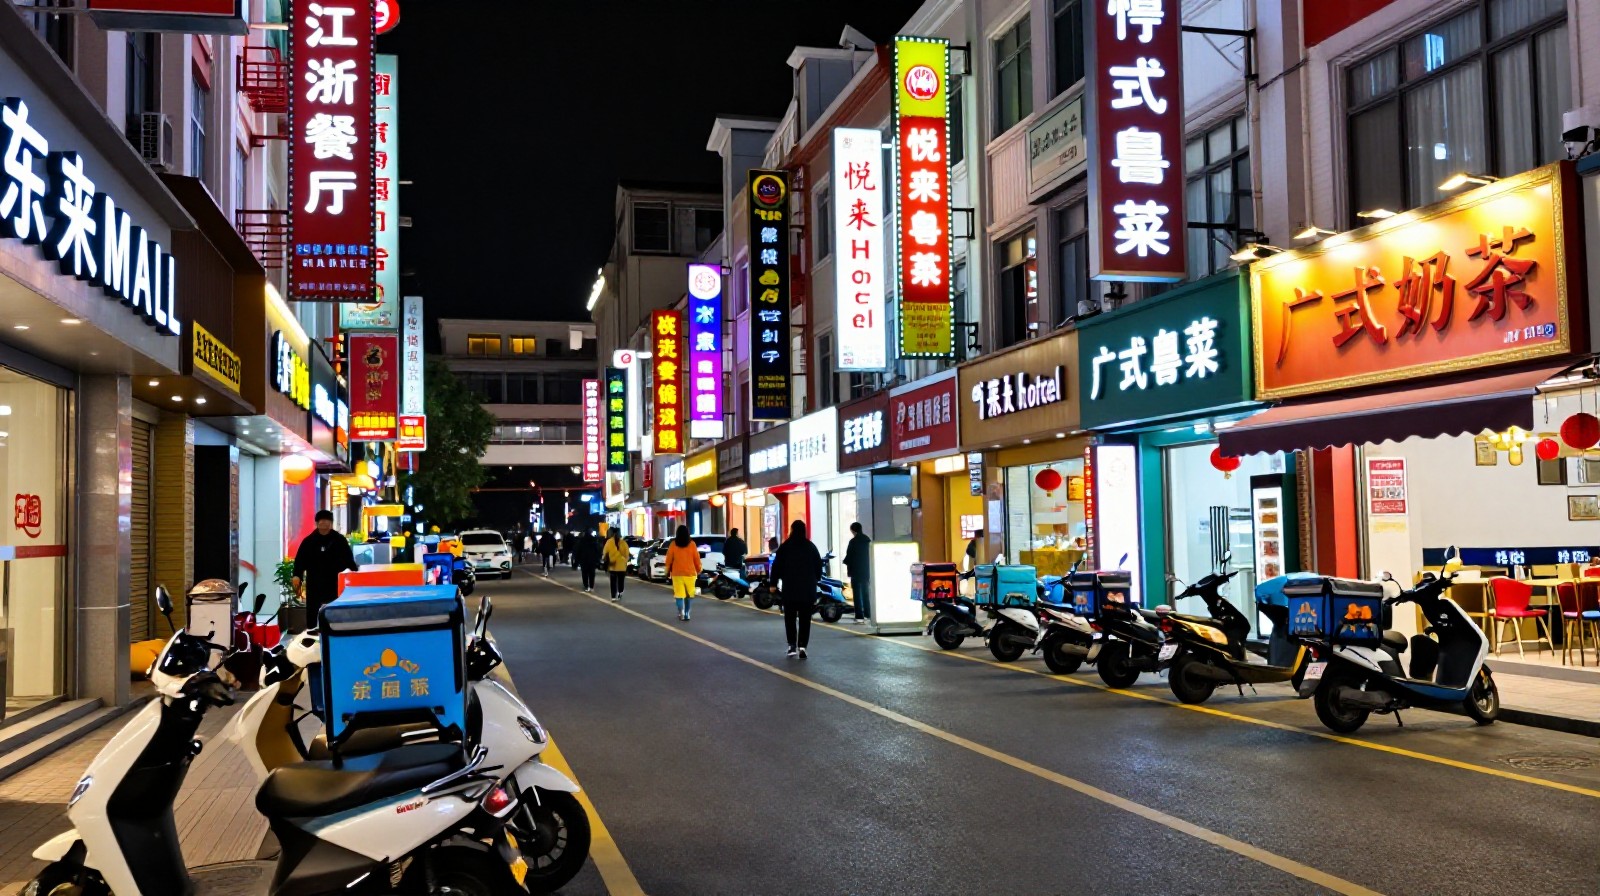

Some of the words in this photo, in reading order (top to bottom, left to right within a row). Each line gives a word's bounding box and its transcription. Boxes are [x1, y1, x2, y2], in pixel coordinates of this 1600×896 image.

[304, 2, 359, 216] 江浙餐厅
[1090, 316, 1219, 400] 广式粤菜
[1276, 226, 1537, 364] 广式奶茶
